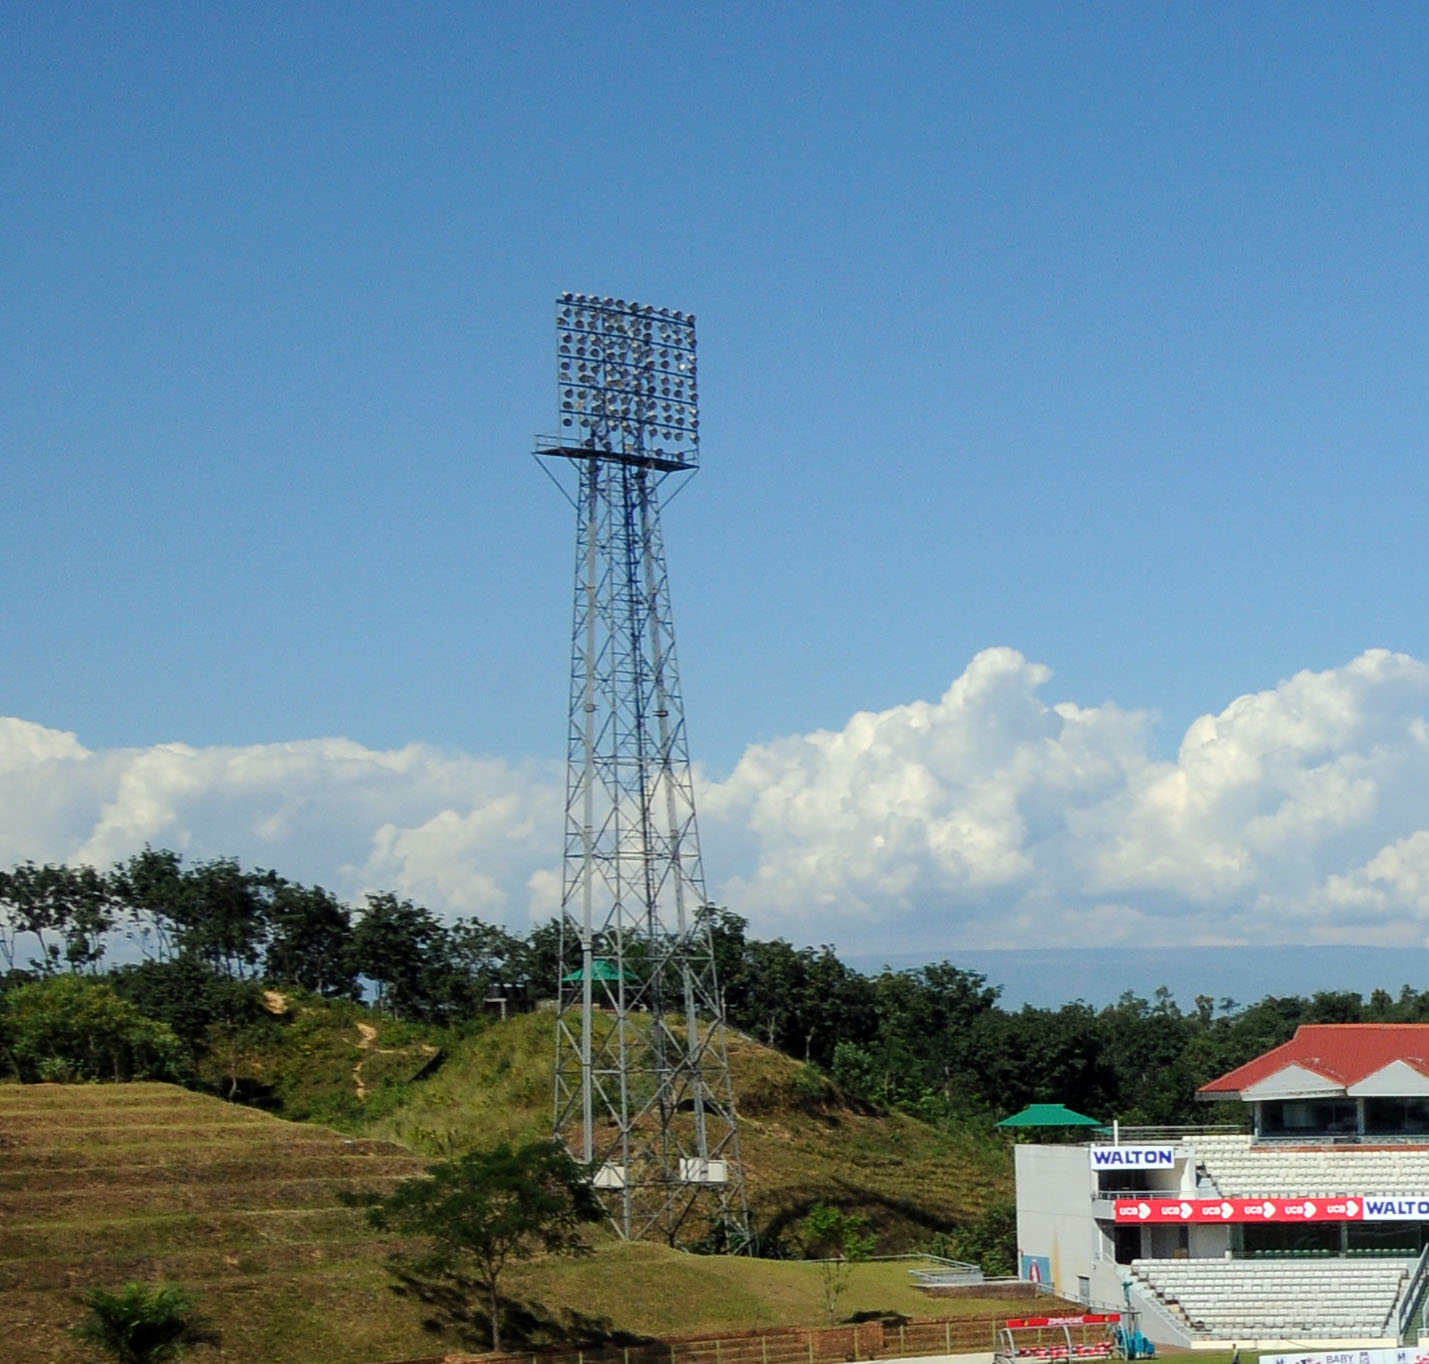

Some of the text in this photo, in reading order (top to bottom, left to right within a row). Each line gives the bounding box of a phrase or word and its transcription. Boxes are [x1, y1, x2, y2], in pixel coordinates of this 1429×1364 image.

[1094, 1150, 1173, 1165] WALTON
[1119, 1206, 1138, 1216] UCB
[1161, 1206, 1180, 1215] UCB
[1202, 1206, 1221, 1215] UCB
[1244, 1205, 1263, 1214] UCB
[1284, 1205, 1303, 1214] UCB
[1327, 1204, 1346, 1213] UCB
[1326, 1354, 1354, 1364] BABY
